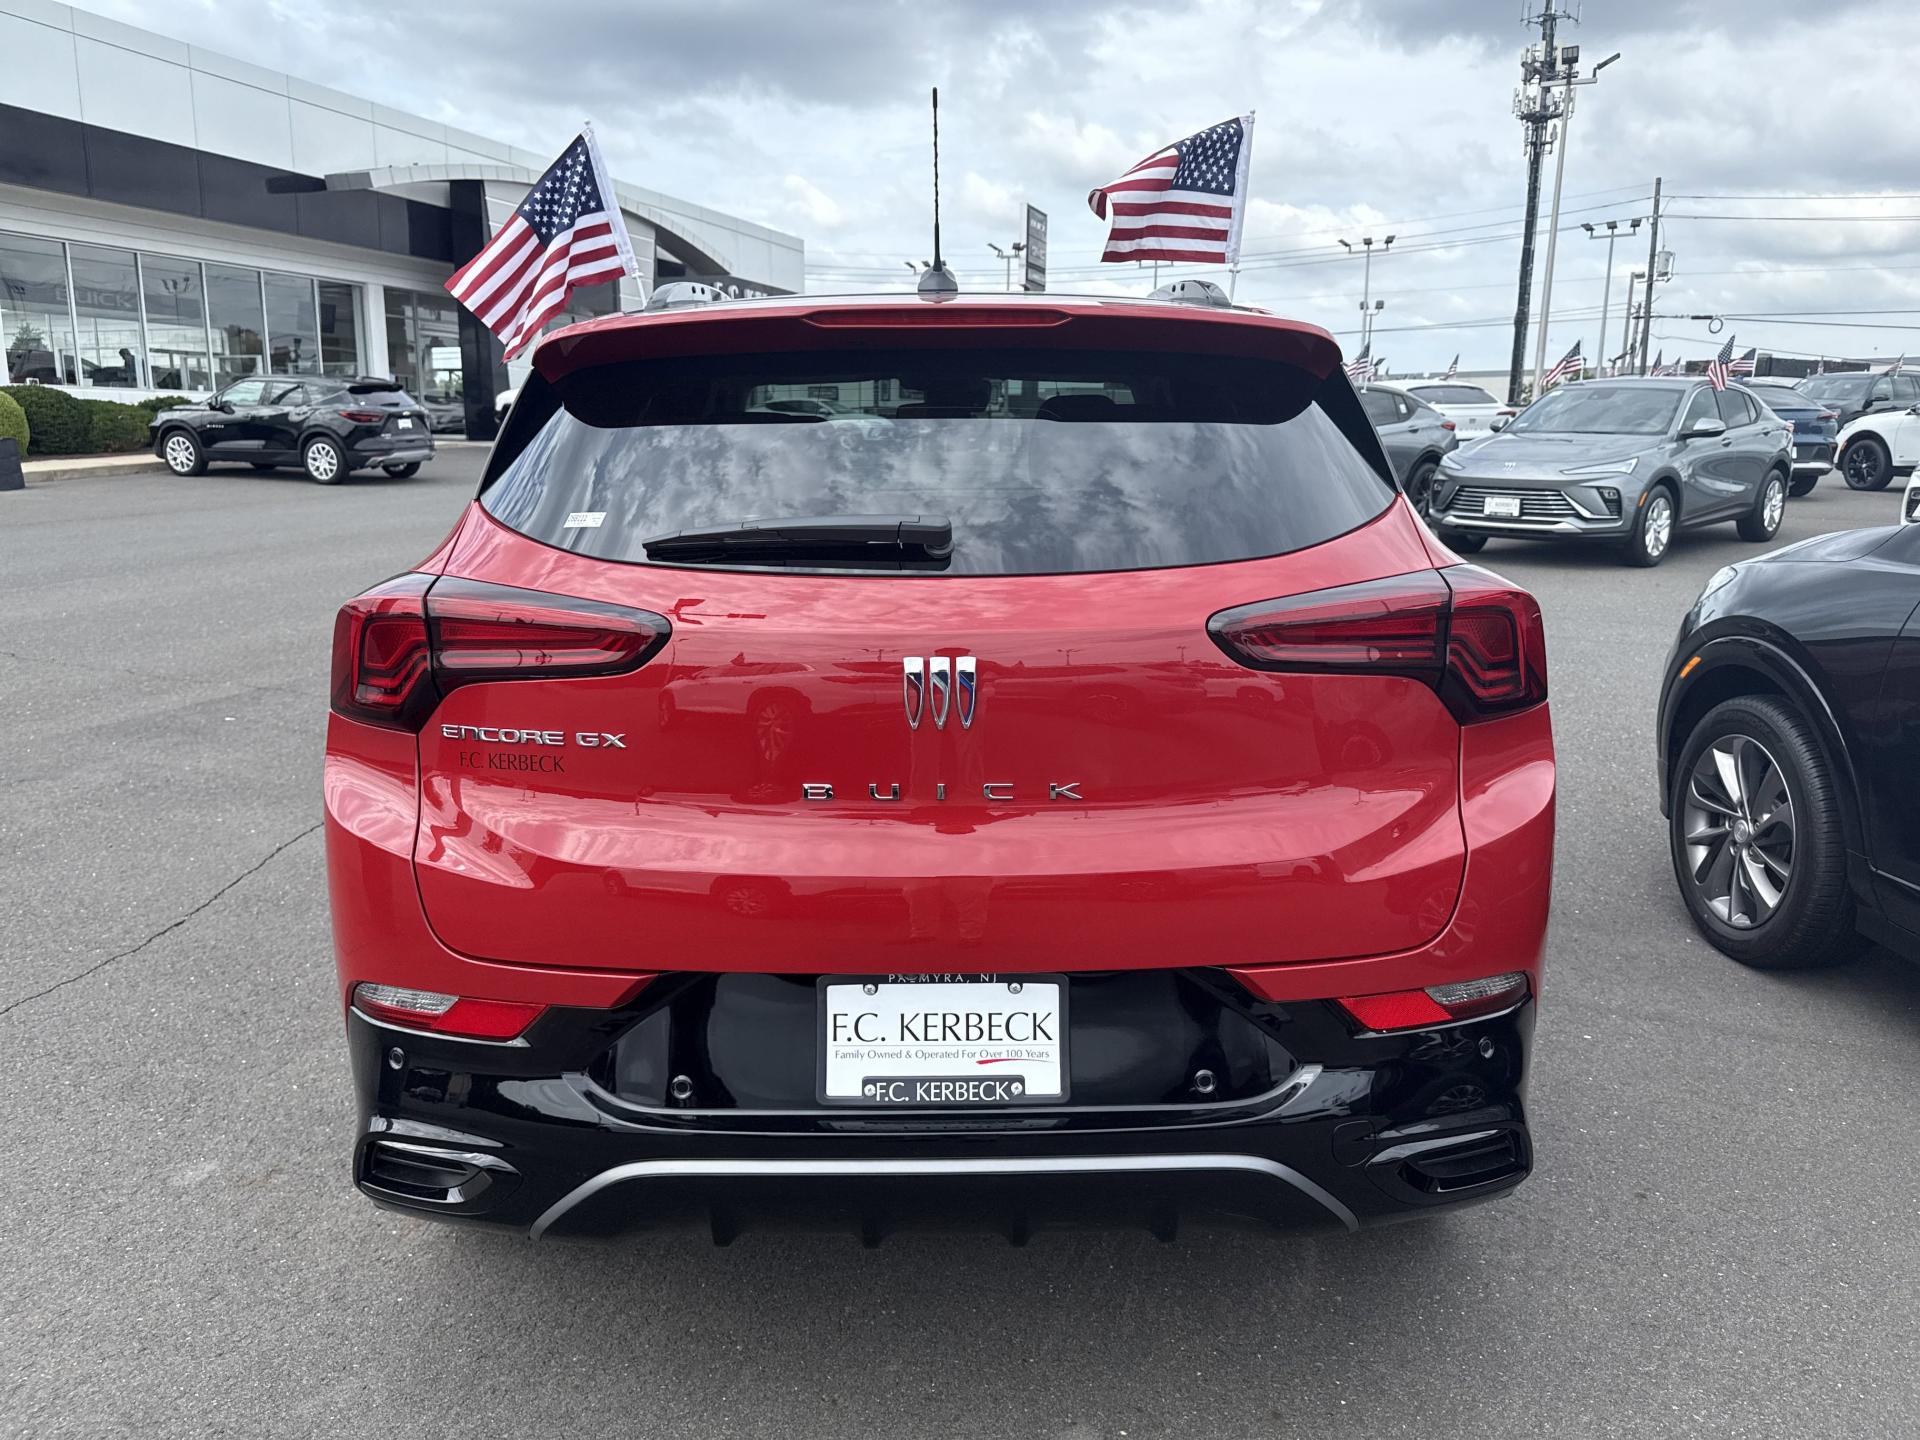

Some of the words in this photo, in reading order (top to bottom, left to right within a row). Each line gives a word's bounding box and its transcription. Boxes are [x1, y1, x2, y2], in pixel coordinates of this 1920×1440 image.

[441, 724, 565, 745] ENCORE
[576, 732, 626, 748] GX
[459, 752, 483, 769] F.C.
[489, 753, 565, 772] KERBECK
[802, 783, 1083, 801] BUICK
[832, 1012, 886, 1042] F.C.
[900, 1012, 1053, 1042] KERBECK
[835, 1049, 865, 1061] Family
[867, 1049, 902, 1059] Owned
[905, 1050, 912, 1059] &
[915, 1049, 959, 1060] Operated
[962, 1049, 976, 1059] For
[980, 1049, 1003, 1059] Over
[1006, 1049, 1023, 1059] 100
[1026, 1049, 1050, 1059] Years
[875, 1082, 909, 1101] F.C.
[916, 1081, 1010, 1101] KERBECK
